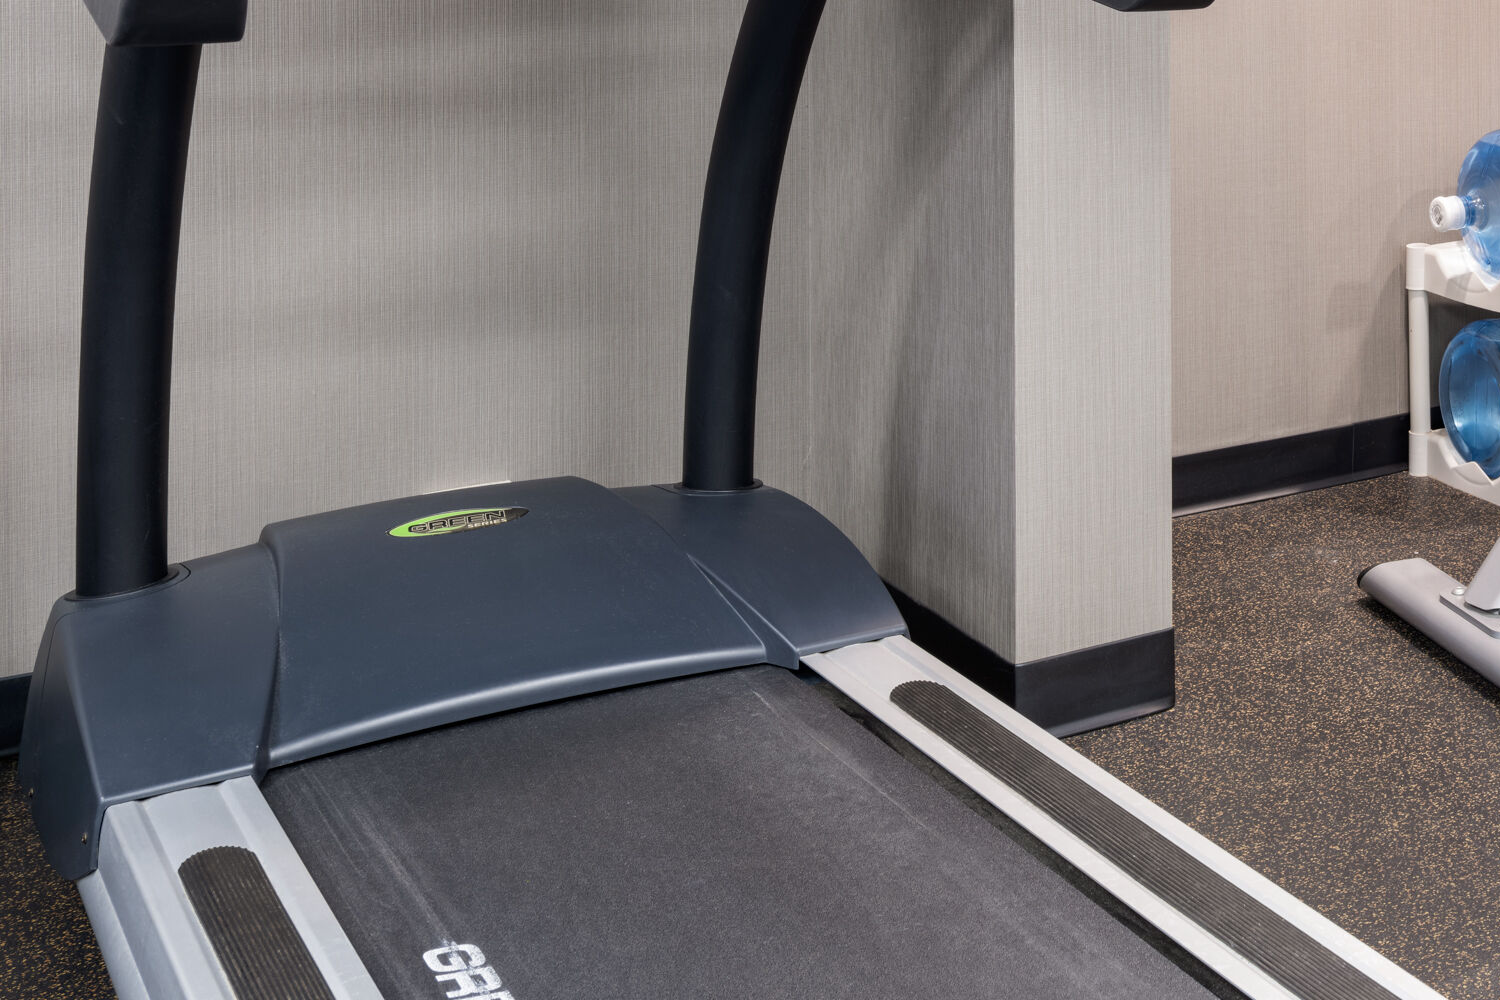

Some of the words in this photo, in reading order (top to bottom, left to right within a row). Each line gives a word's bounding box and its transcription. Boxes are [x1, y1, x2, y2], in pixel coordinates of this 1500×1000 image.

[408, 510, 506, 533] GREEN
[467, 518, 507, 528] SERIES
[422, 943, 515, 1000] GR
